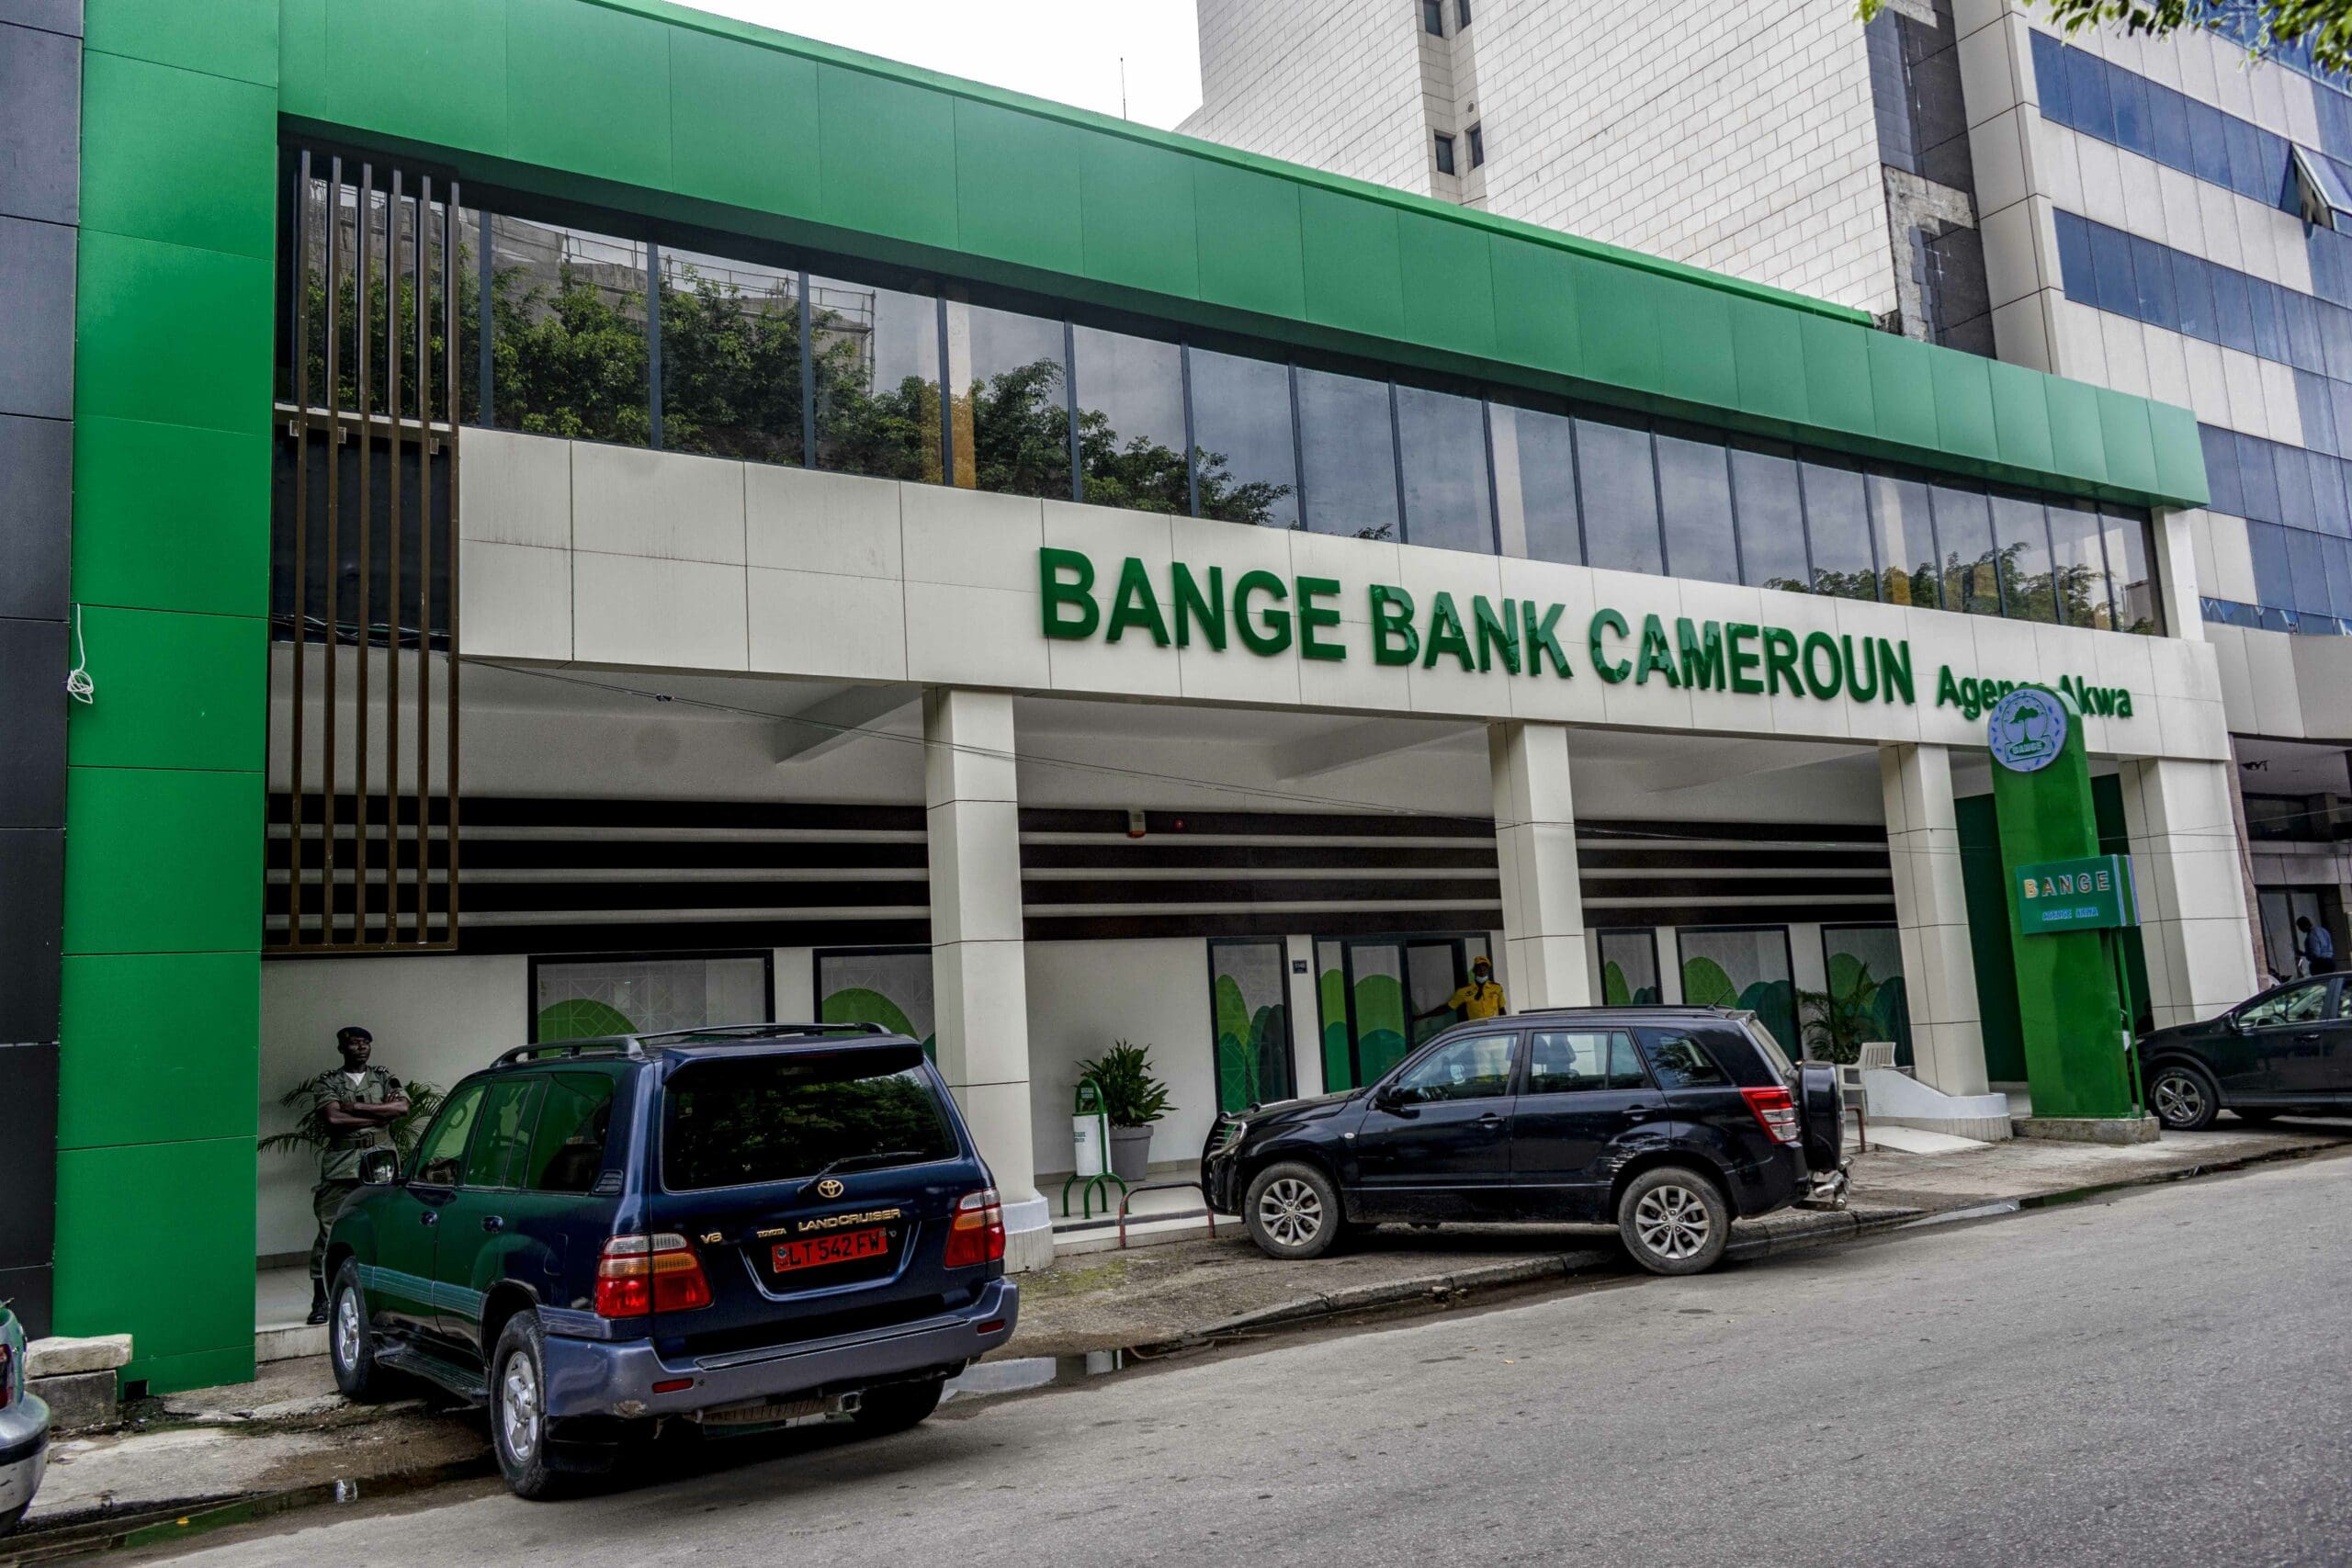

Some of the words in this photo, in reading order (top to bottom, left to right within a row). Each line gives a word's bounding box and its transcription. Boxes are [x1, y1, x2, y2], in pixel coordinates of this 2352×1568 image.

[1040, 547, 1346, 660] BANGE
[1370, 584, 1574, 678] BANK
[1589, 608, 1915, 705] CAMEROUN
[2060, 674, 2132, 718] Akwa
[2023, 870, 2110, 898] BANGE
[700, 1232, 722, 1245] V8
[756, 1227, 787, 1238] TOYOTA
[788, 1242, 812, 1266] LT
[818, 1236, 853, 1260] 542
[857, 1231, 880, 1254] FW
